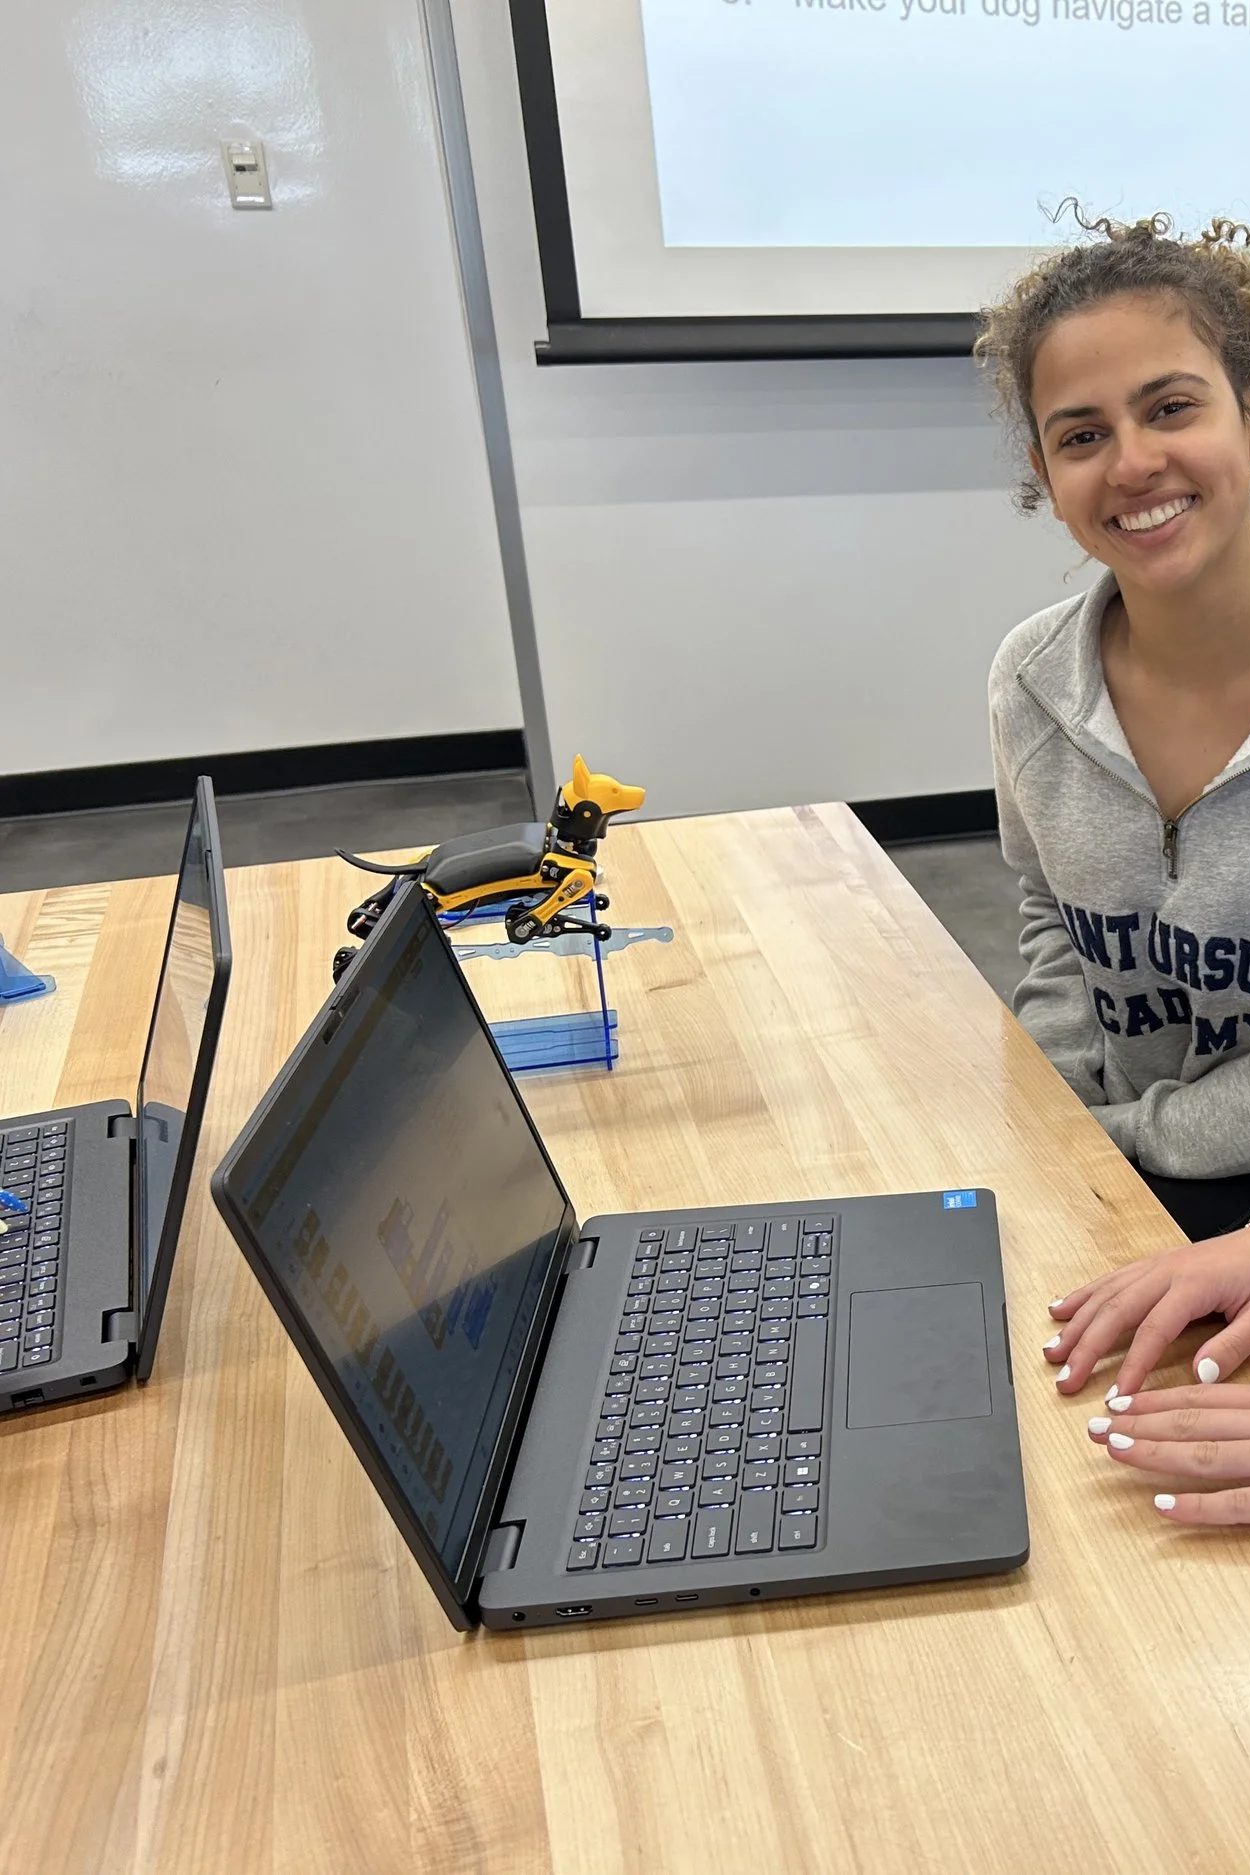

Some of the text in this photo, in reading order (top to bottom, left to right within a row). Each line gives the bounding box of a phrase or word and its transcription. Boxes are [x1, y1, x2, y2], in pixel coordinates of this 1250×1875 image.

[899, 0, 966, 21] your
[981, 0, 1040, 27] dog
[1052, 0, 1182, 30] navigate
[1192, 6, 1210, 25] a
